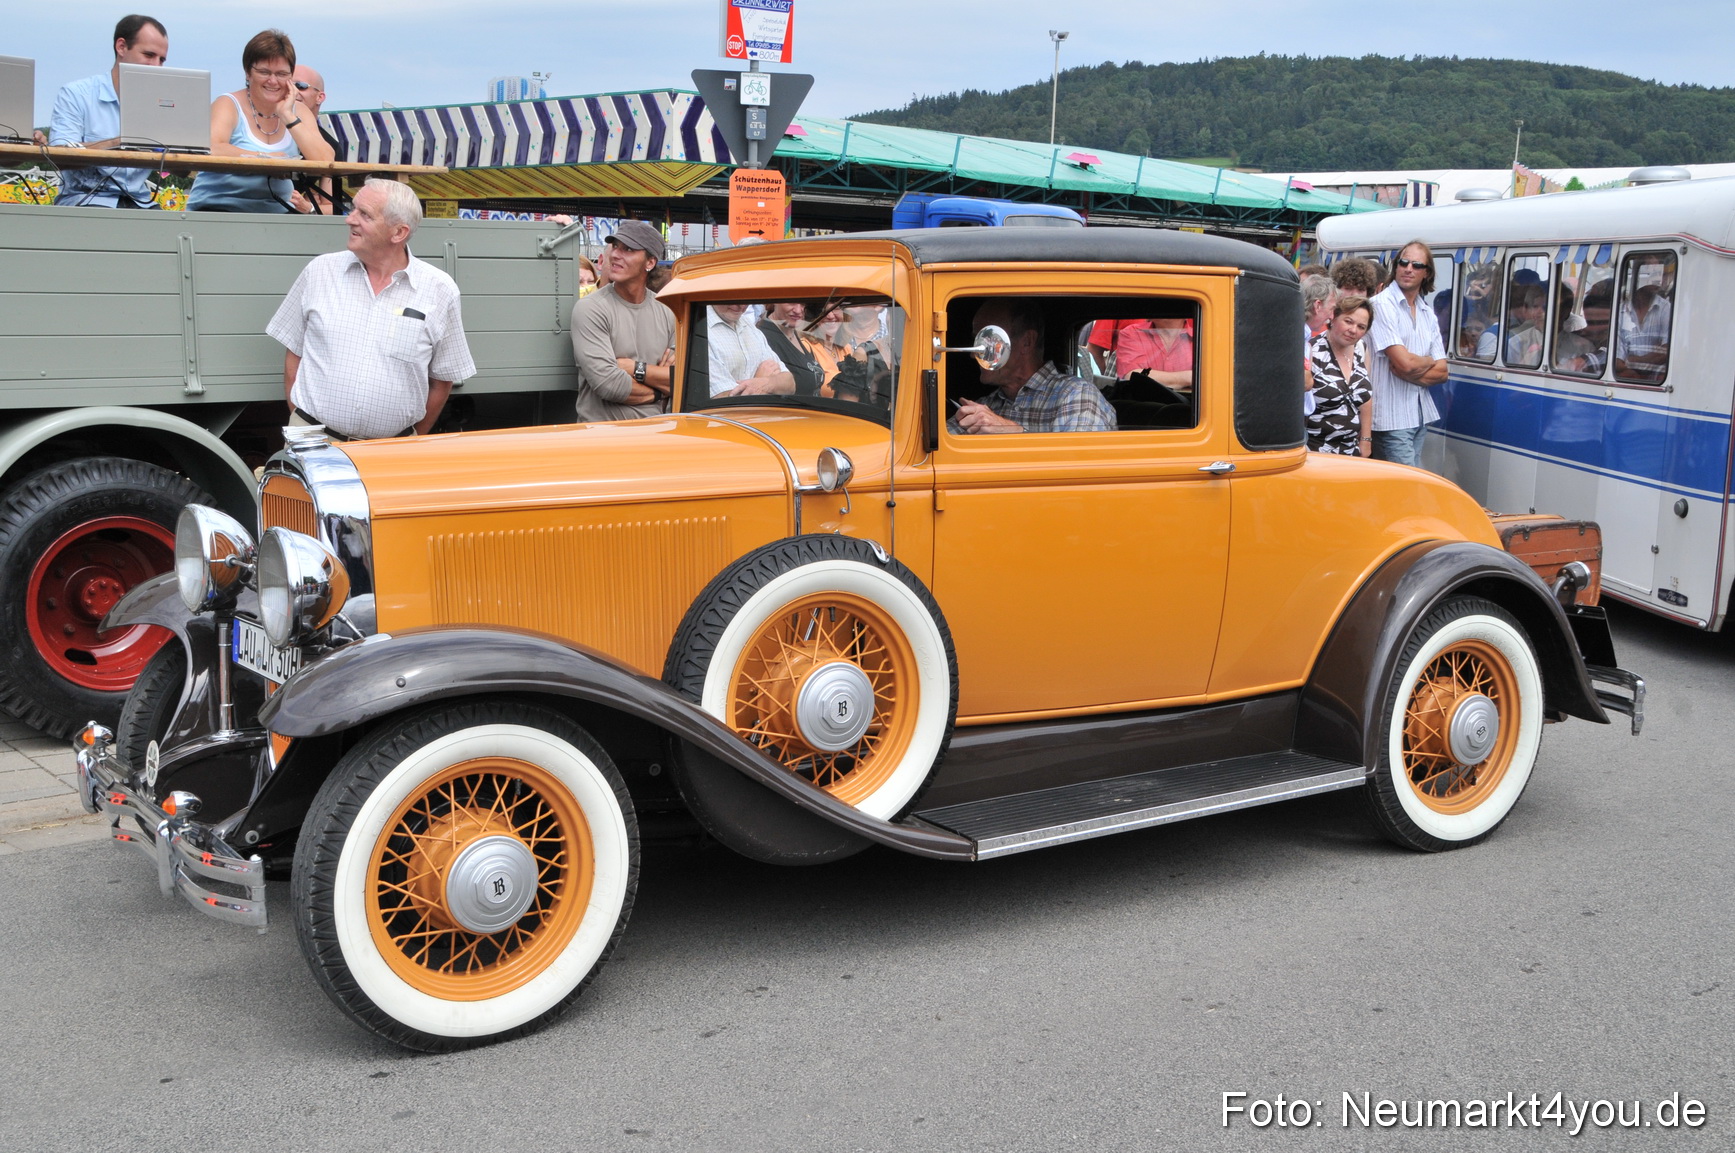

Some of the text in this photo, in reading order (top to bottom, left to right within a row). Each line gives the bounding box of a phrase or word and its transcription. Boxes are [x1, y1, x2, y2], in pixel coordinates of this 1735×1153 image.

[728, 41, 742, 50] STOP
[759, 50, 780, 60] 800m
[752, 112, 758, 120] S
[735, 175, 782, 184] Schützenhaus
[736, 185, 780, 193] Wappersdorf
[238, 625, 256, 665] LAU
[837, 700, 848, 717] B
[493, 877, 506, 898] B
